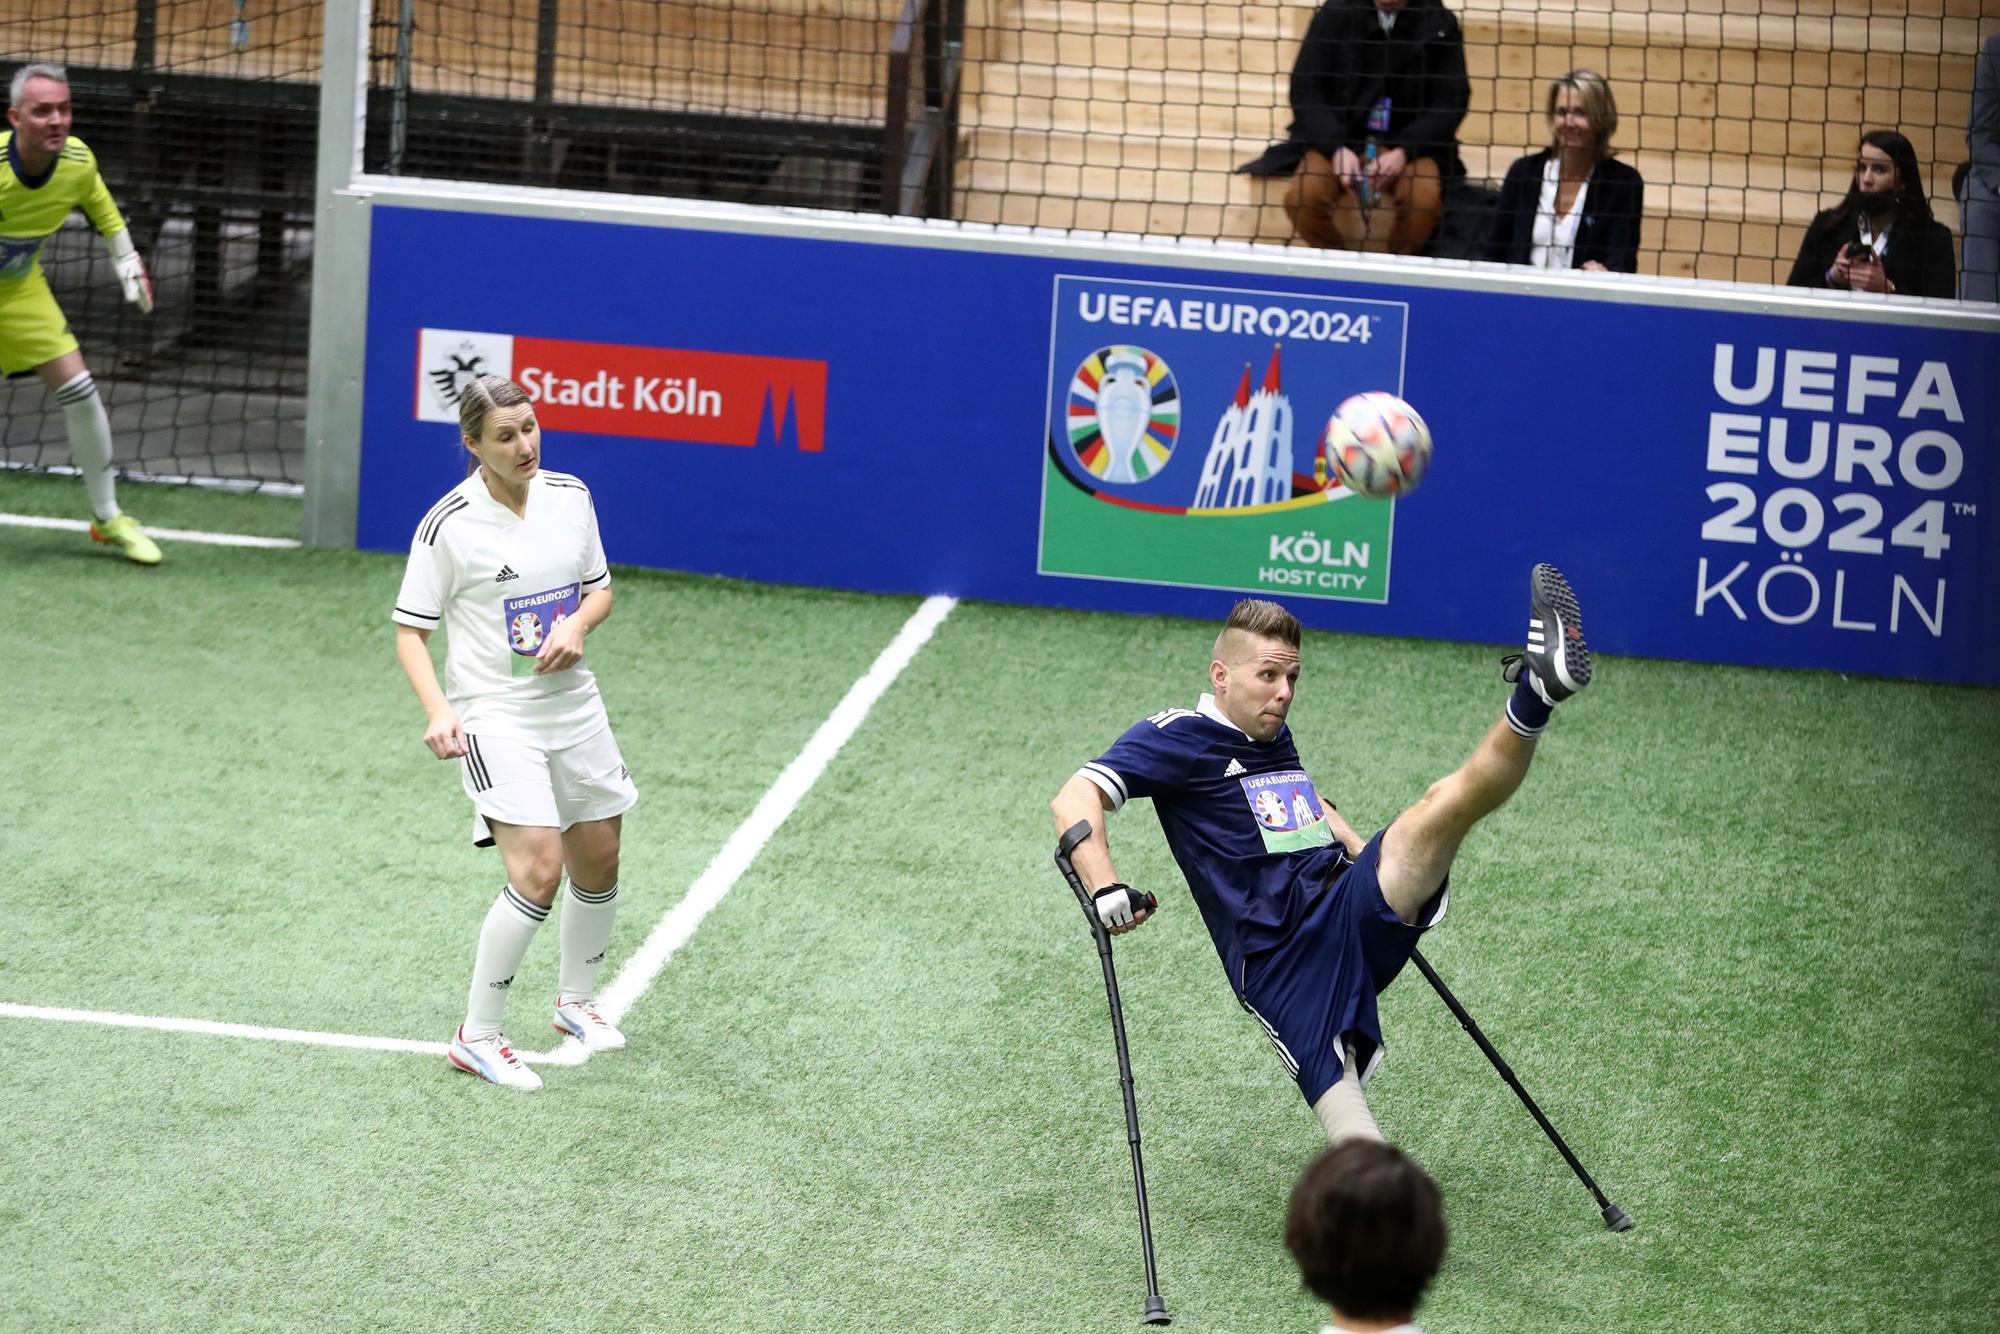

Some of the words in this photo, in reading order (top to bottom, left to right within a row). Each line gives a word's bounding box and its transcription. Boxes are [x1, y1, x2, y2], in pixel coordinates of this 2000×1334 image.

[520, 367, 625, 410] Stadt
[633, 375, 722, 418] Köln
[1712, 343, 1965, 423] UEFA
[1706, 412, 1964, 491] EURO
[1268, 530, 1370, 568] KÖLN
[1701, 481, 1951, 560] 2024
[495, 573, 520, 583] adidas
[1258, 566, 1316, 586] HOST
[1316, 573, 1367, 590] CITY
[1695, 550, 1946, 638] KÖLN
